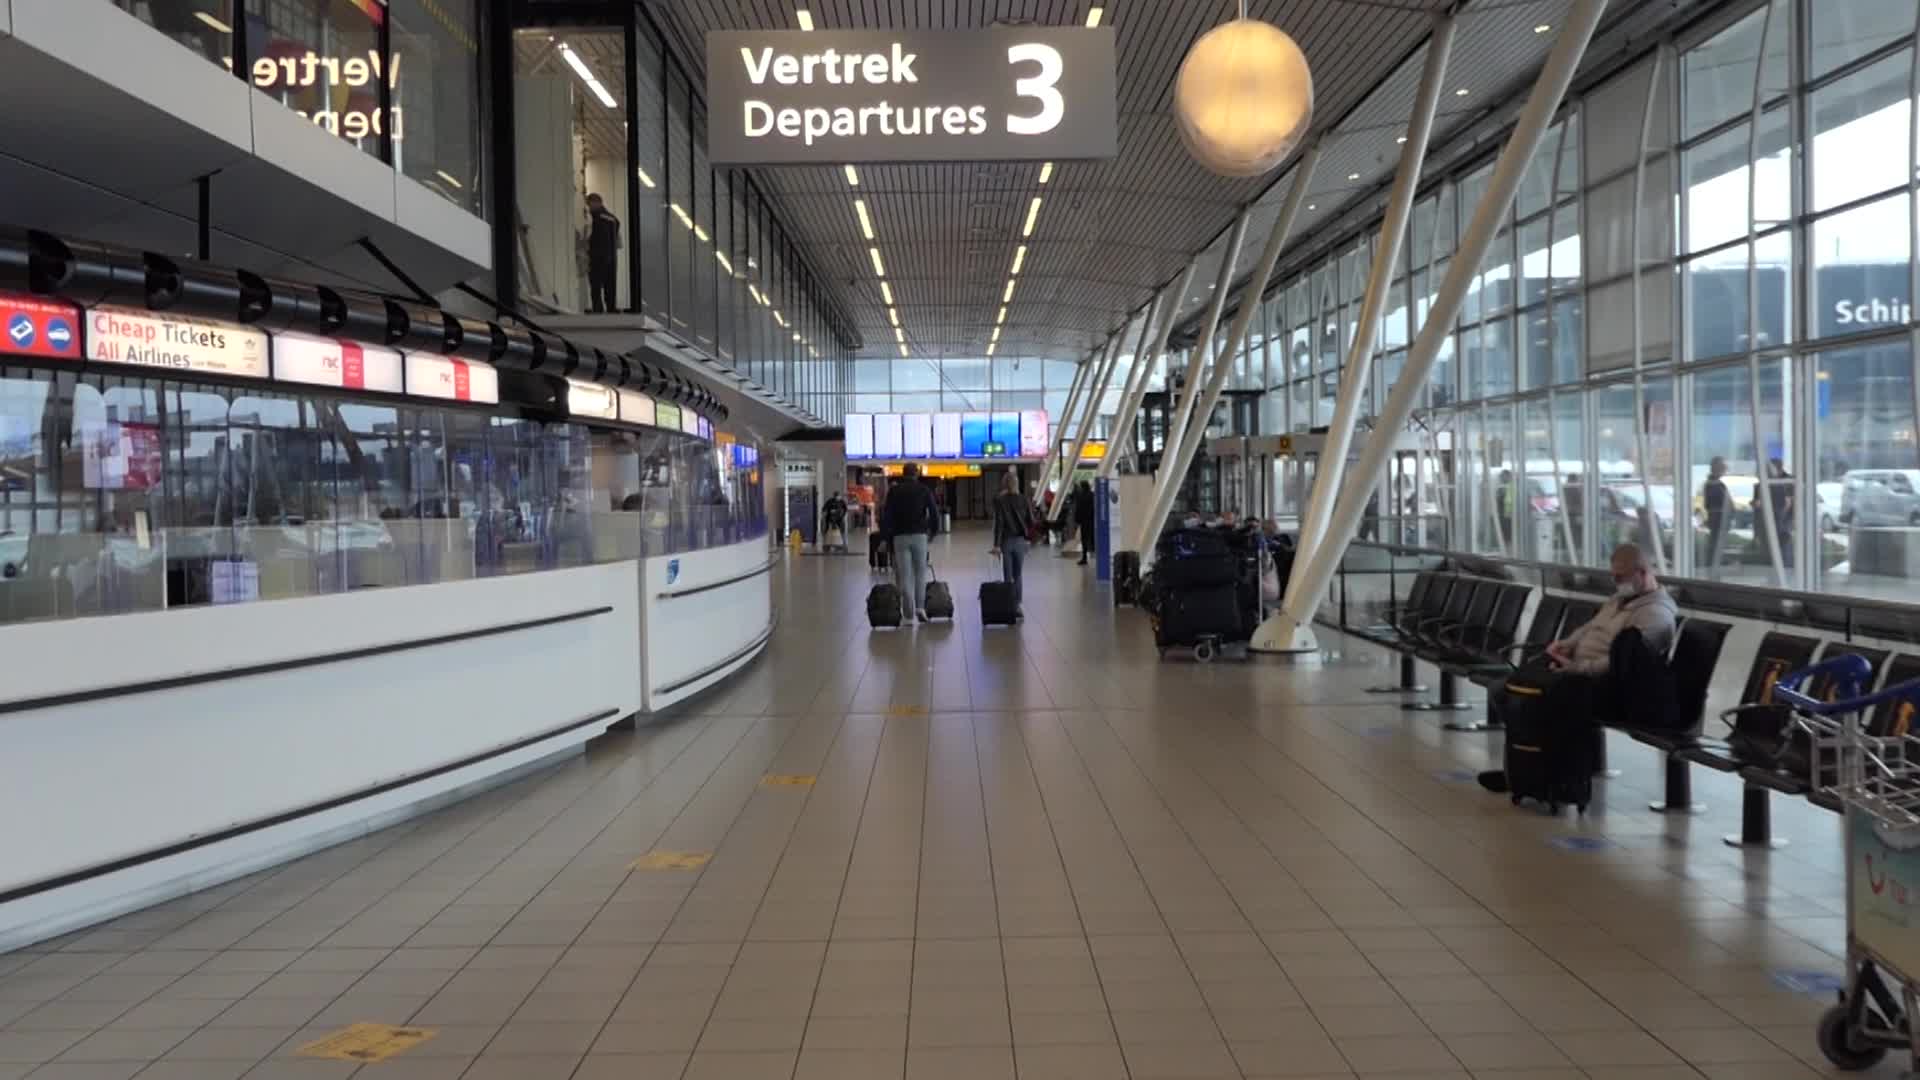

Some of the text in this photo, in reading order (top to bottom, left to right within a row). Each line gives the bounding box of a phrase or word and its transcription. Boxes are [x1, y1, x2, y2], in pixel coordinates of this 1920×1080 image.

[740, 43, 919, 85] Vertrek
[1006, 43, 1064, 135] 3
[743, 101, 987, 145] Departures
[94, 314, 156, 344] Cheap
[162, 323, 226, 349] Tickets
[96, 341, 119, 361] All
[126, 344, 191, 368] Airlines
